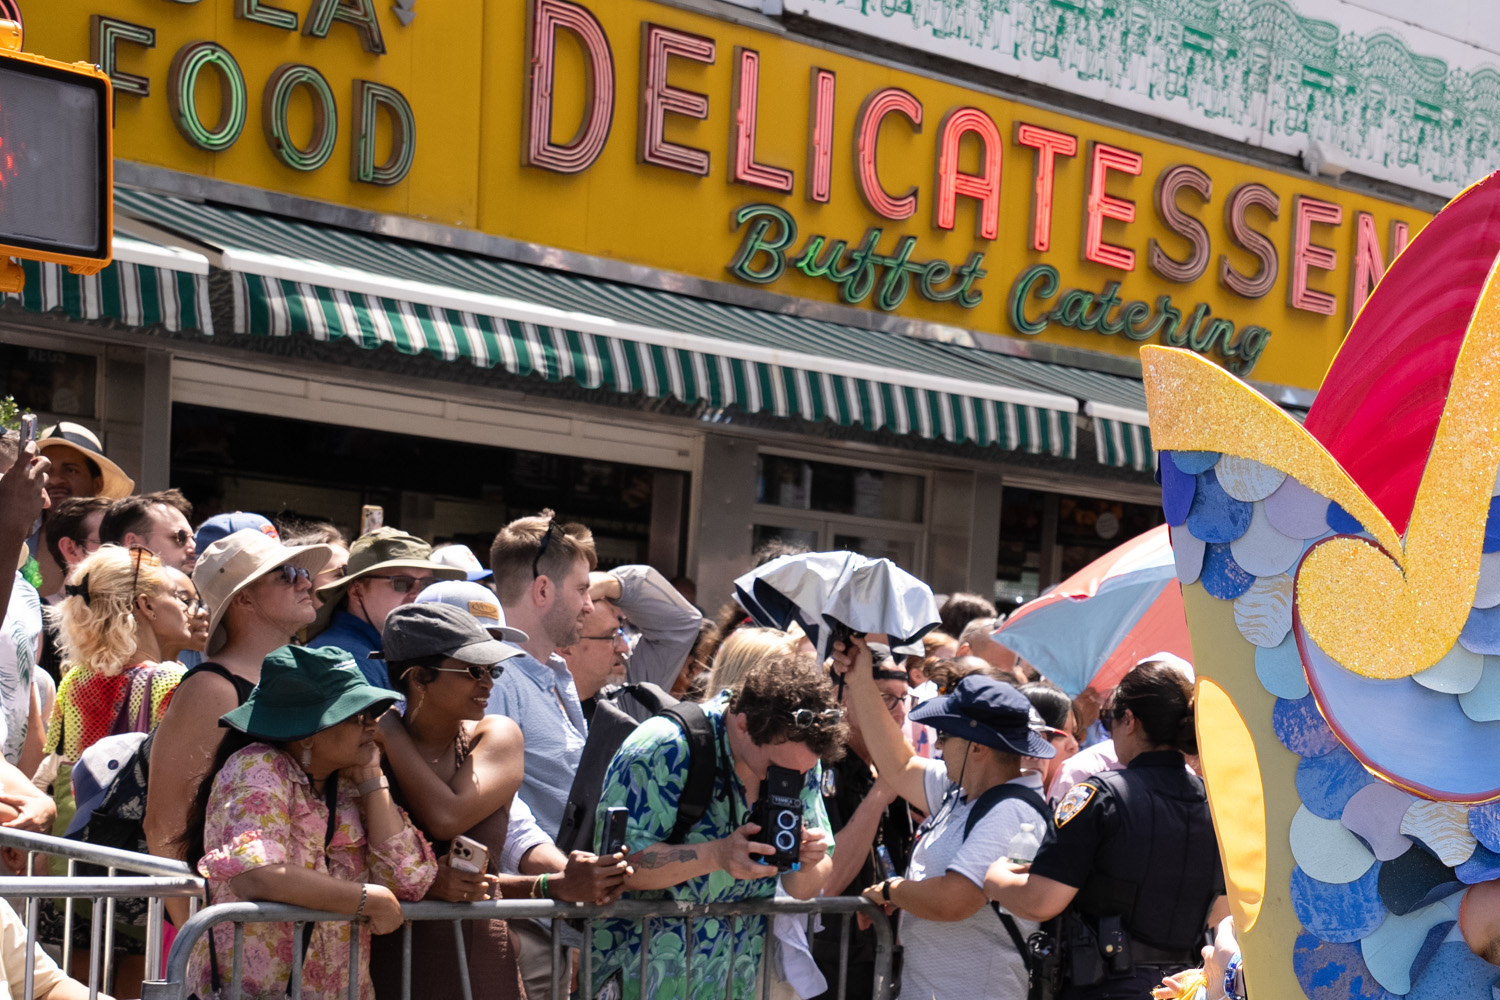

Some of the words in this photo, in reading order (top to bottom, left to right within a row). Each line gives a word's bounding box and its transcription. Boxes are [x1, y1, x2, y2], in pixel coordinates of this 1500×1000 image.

[90, 14, 416, 187] FOOD
[521, 0, 1410, 332] DELICATESSEN
[726, 203, 988, 311] Buffet
[1009, 263, 1272, 377] Catering
